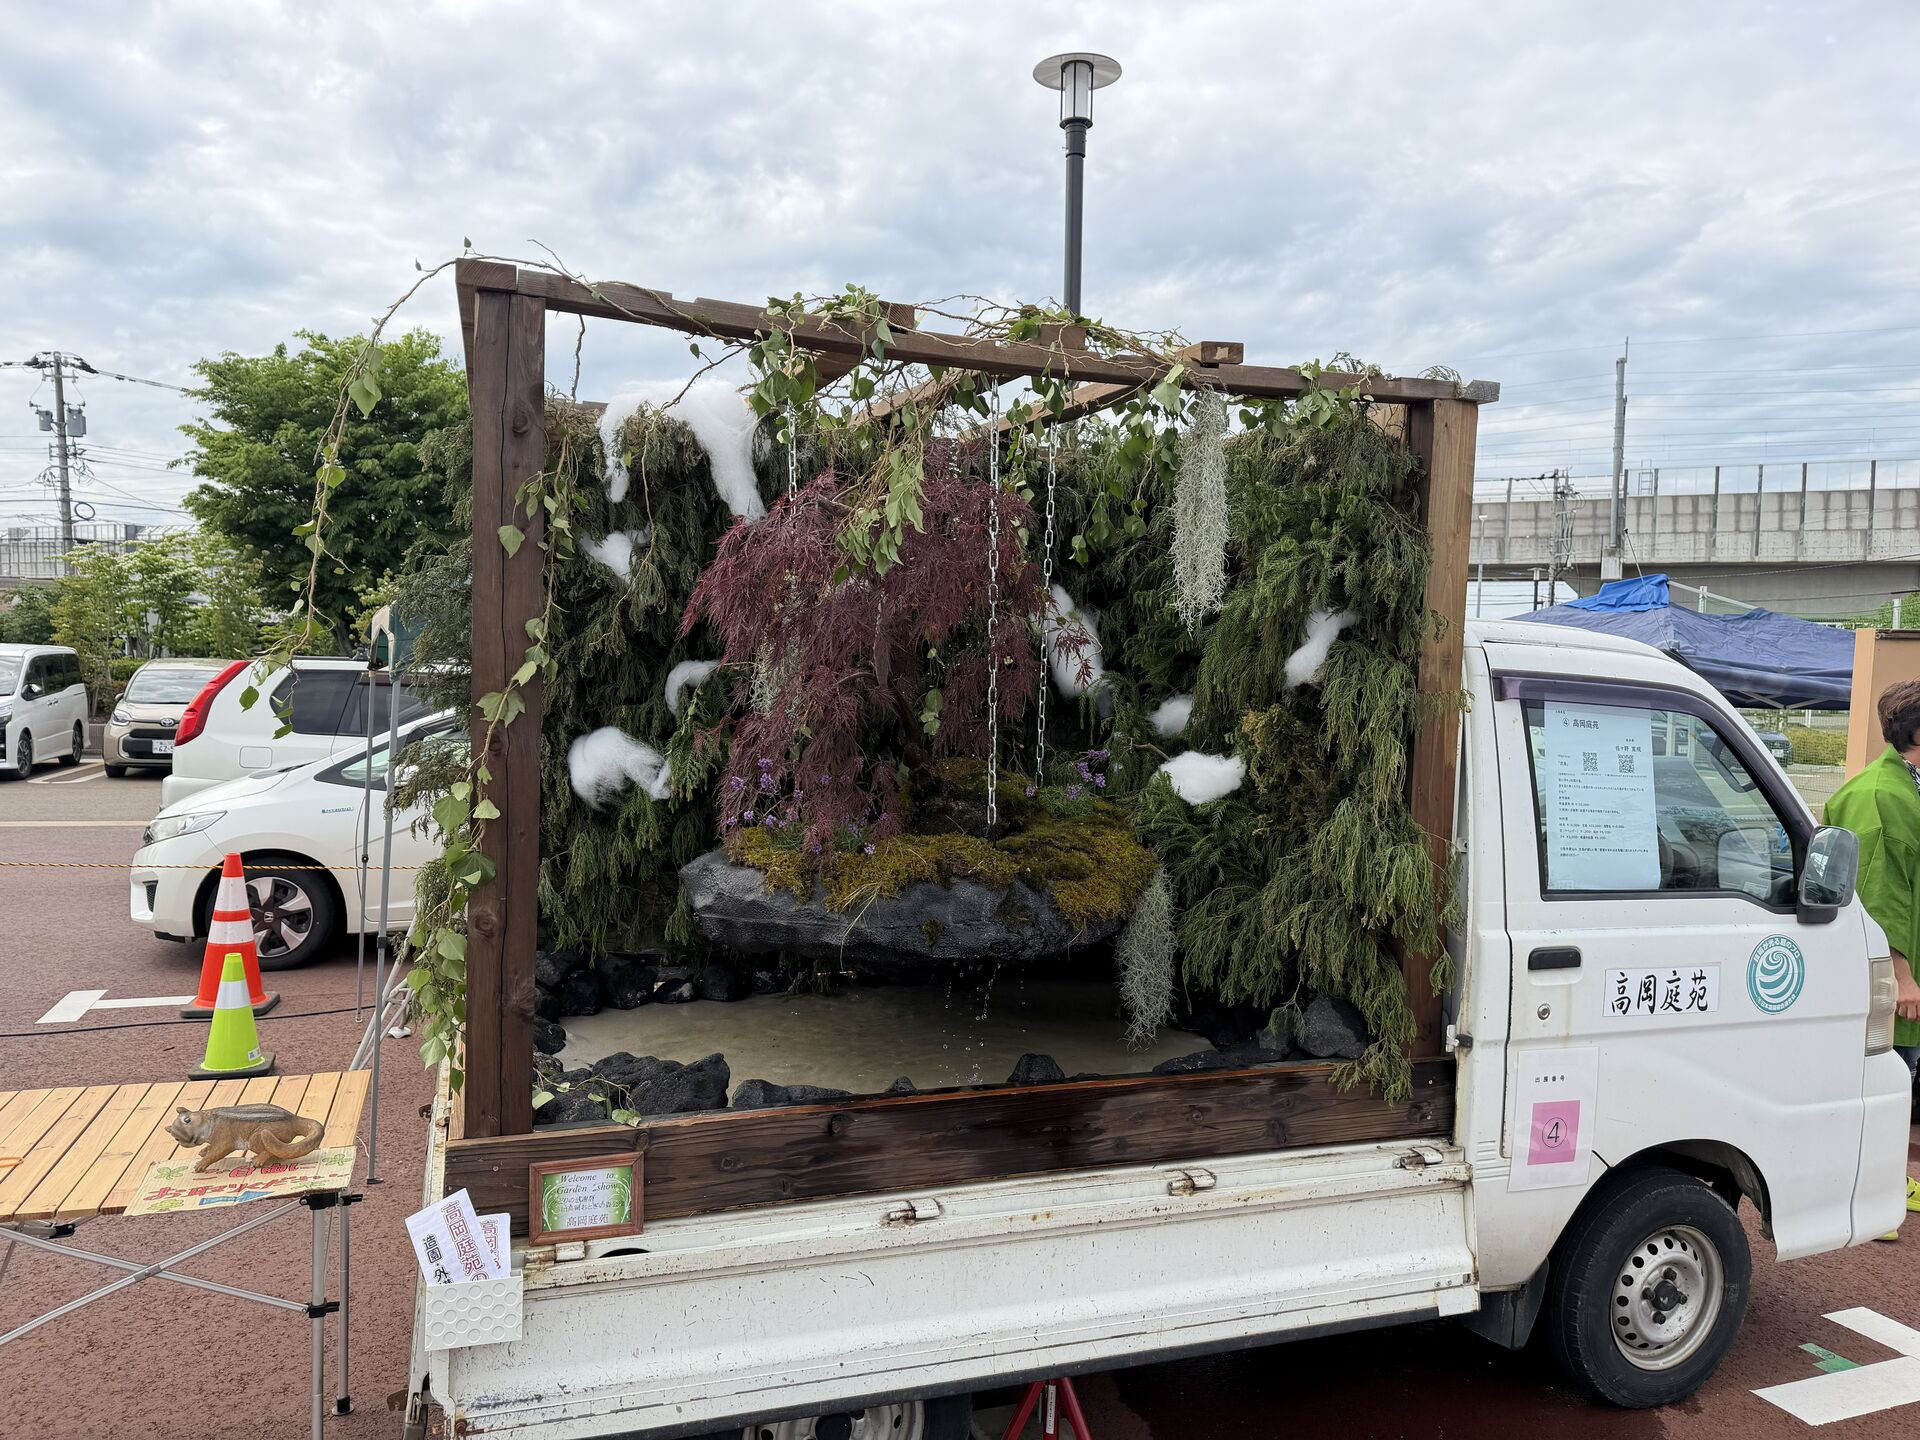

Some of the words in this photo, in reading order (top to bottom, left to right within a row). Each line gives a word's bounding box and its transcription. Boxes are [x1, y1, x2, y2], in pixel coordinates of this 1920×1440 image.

[1573, 719, 1599, 729] 高岡庭苑
[1611, 969, 1708, 1015] 高岡庭苑
[560, 1174, 597, 1183] Welcome
[556, 1185, 588, 1194] Garden
[567, 1214, 609, 1227] 高岡庭苑
[423, 1233, 453, 1284] 造園・外
